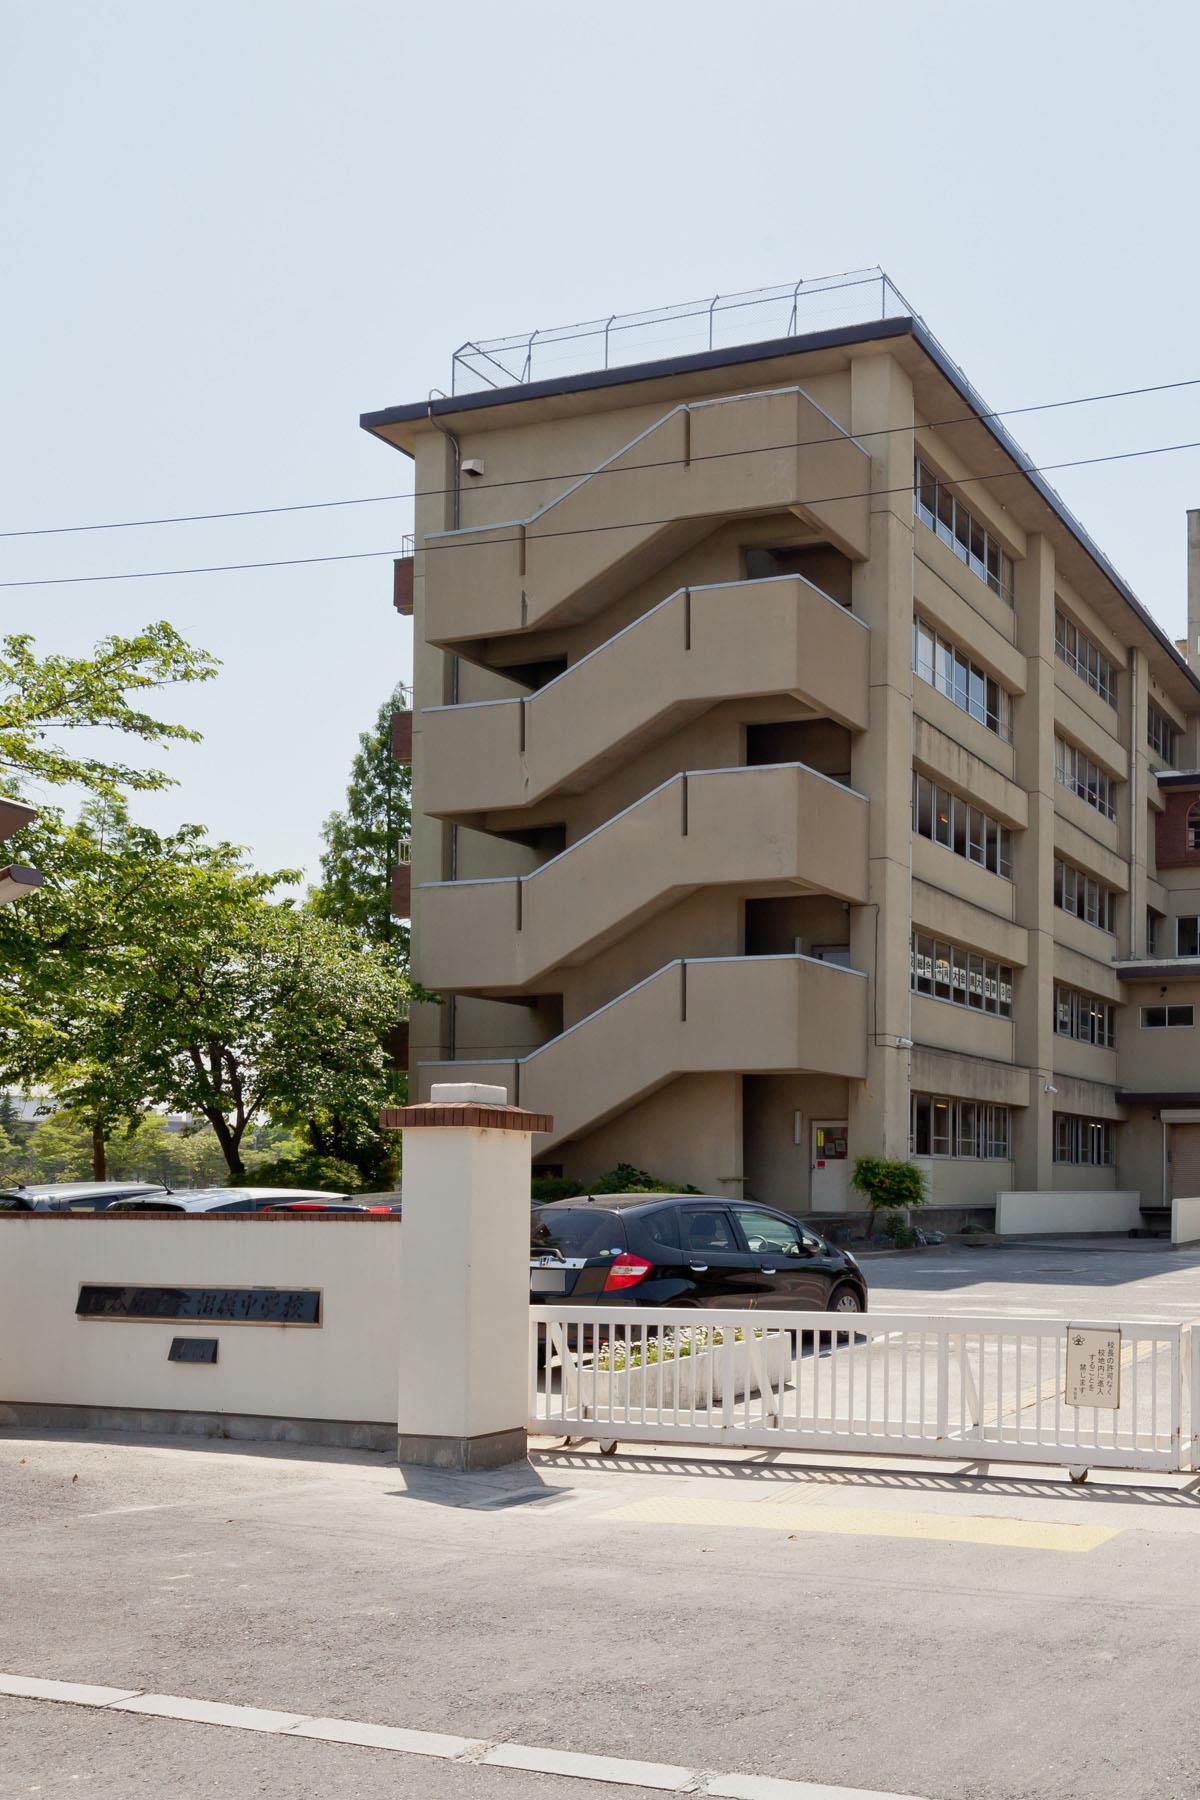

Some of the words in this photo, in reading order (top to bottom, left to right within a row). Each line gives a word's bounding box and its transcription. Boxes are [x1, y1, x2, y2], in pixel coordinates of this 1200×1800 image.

[1088, 1353, 1097, 1392] することを
